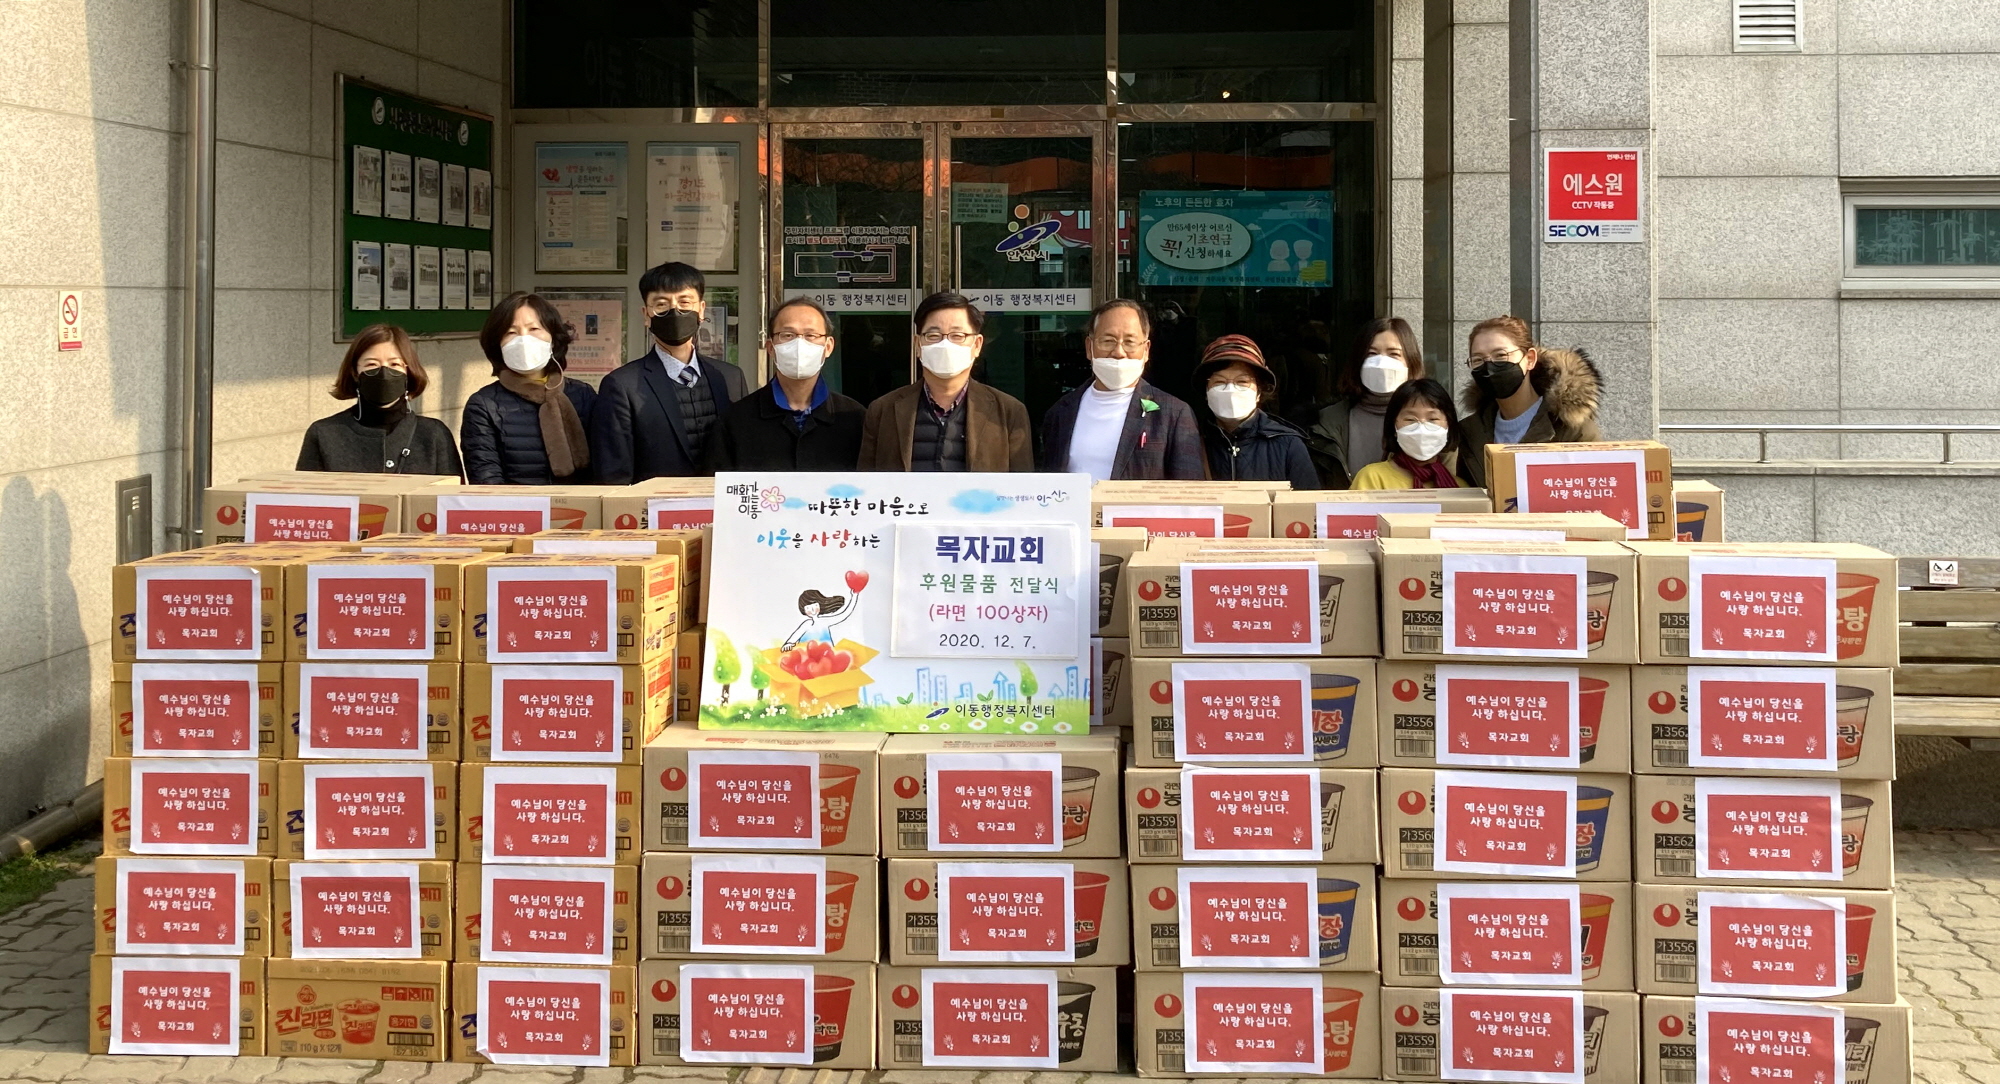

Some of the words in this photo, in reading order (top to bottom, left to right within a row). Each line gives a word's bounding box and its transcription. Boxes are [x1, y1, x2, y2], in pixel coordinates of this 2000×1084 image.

[1563, 173, 1623, 196] 에스원
[1155, 197, 1182, 208] 노후의
[1184, 197, 1212, 208] 든든한
[1215, 197, 1234, 208] 효자
[1571, 201, 1593, 209] CCTV
[1593, 201, 1615, 209] 작동중
[784, 226, 823, 235] 주민자치센터
[824, 226, 850, 235] 프로그램
[890, 226, 911, 235] 아래에
[1166, 223, 1206, 232] 만65세이상
[1209, 222, 1233, 232] 어르신
[1549, 225, 1599, 237] SECOM
[785, 236, 806, 244] 표시된
[806, 236, 820, 244] 별도
[820, 236, 848, 245] 출입구를
[848, 236, 880, 245] 이용하시기
[881, 236, 911, 245] 바랍니다.
[1186, 233, 1233, 246] 기초연금
[1159, 237, 1183, 259] 꼭!
[1183, 246, 1233, 259] 신청하세요
[1006, 250, 1050, 262] 안산시
[815, 294, 837, 307] 이동
[842, 293, 907, 307] 행정복지센터
[983, 294, 1005, 307] 이동
[1010, 293, 1076, 307] 행정복지센터
[726, 481, 759, 496] 매화가
[1543, 477, 1584, 488] 예수님이
[1588, 476, 1618, 488] 당신을
[741, 493, 760, 505] 피는
[1549, 489, 1570, 500] 사랑
[1573, 489, 1617, 500] 하십니다.
[738, 504, 762, 520] 이동
[808, 497, 862, 517] 따뜻한
[867, 496, 930, 517] 마음으로
[269, 518, 305, 529] 예수님이
[308, 519, 334, 530] 당신을
[461, 522, 496, 532] 예수님이
[499, 522, 526, 533] 당신을
[273, 529, 291, 539] 사랑
[293, 530, 333, 540] 하십니다.
[757, 528, 804, 549] 이웃을
[810, 529, 881, 549] 사랑하는
[935, 536, 1044, 564] 목자교회
[919, 573, 998, 595] 후원물품
[1009, 574, 1059, 595] 전달식
[1209, 584, 1252, 596] 예수님이
[1256, 583, 1288, 596] 당신을
[162, 593, 201, 605] 예수님이
[204, 593, 233, 605] 당신을
[1215, 597, 1237, 609] 사랑
[1240, 596, 1287, 609] 하십니다.
[1719, 590, 1765, 602] 예수님이
[1770, 590, 1804, 604] 당신을
[167, 605, 187, 617] 사랑
[189, 605, 231, 617] 하십니다.
[928, 604, 966, 623] (라면
[976, 604, 1049, 623] 100상자)
[1141, 608, 1177, 620] 가3559
[1726, 603, 1749, 616] 사랑
[1752, 604, 1802, 617] 하십니다.
[1231, 619, 1271, 631] 목자교회
[1404, 612, 1442, 625] 가3562
[181, 627, 217, 638] 목자교회
[1742, 627, 1784, 639] 목자교회
[939, 633, 985, 649] 2020.
[993, 634, 1015, 649] 12.
[1023, 634, 1036, 649] 7.
[518, 693, 559, 705] 예수님이
[563, 693, 594, 706] 당신을
[1465, 694, 1510, 707] 예수님이
[1514, 695, 1547, 708] 당신을
[524, 706, 544, 718] 사랑
[547, 706, 592, 718] 하십니다.
[955, 702, 1056, 719] 이동행정복지센터
[1471, 707, 1494, 720] 사랑
[1497, 708, 1546, 721] 하십니다.
[1396, 716, 1433, 729] 가3556
[538, 728, 576, 740] 목자교회
[1487, 731, 1528, 743] 목자교회
[716, 779, 757, 791] 예수님이
[761, 779, 792, 791] 당신을
[331, 791, 372, 803] 예수님이
[375, 790, 405, 803] 당신을
[721, 791, 742, 804] 사랑
[745, 792, 790, 804] 하십니다.
[337, 804, 357, 816] 사랑
[360, 804, 404, 816] 하십니다.
[900, 810, 928, 822] 가356
[736, 814, 774, 826] 목자교회
[1140, 816, 1176, 829] 가3559
[352, 826, 389, 837] 목자교회
[1656, 836, 1694, 848] 가3562
[143, 886, 183, 898] 예수님이
[186, 886, 216, 899] 당신을
[147, 899, 170, 911] 사랑
[172, 899, 214, 911] 하십니다.
[1207, 897, 1250, 909] 예수님이
[1255, 896, 1287, 909] 당신을
[1213, 910, 1235, 922] 사랑
[1238, 910, 1285, 922] 하십니다.
[162, 921, 199, 932] 목자교회
[1728, 922, 1774, 935] 예수님이
[1779, 923, 1812, 936] 당신을
[1229, 933, 1269, 944] 목자교회
[1400, 934, 1436, 947] 가3561
[1734, 936, 1757, 948] 사랑
[1761, 937, 1811, 950] 하십니다.
[1655, 941, 1693, 954] 가3556
[1751, 960, 1793, 972] 목자교회
[504, 995, 545, 1007] 예수님이
[550, 996, 580, 1009] 당신을
[950, 997, 992, 1010] 예수님이
[996, 997, 1028, 1010] 당신을
[275, 1006, 334, 1035] 진라면
[510, 1008, 530, 1021] 사랑
[534, 1009, 579, 1022] 하십니다.
[956, 1010, 977, 1023] 사랑
[980, 1010, 1026, 1023] 하십니다.
[391, 1017, 416, 1028] 용기면
[524, 1031, 563, 1043] 목자교회
[972, 1033, 1010, 1045] 목자교회
[1395, 1034, 1433, 1047] 가3559
[300, 1043, 312, 1052] 110
